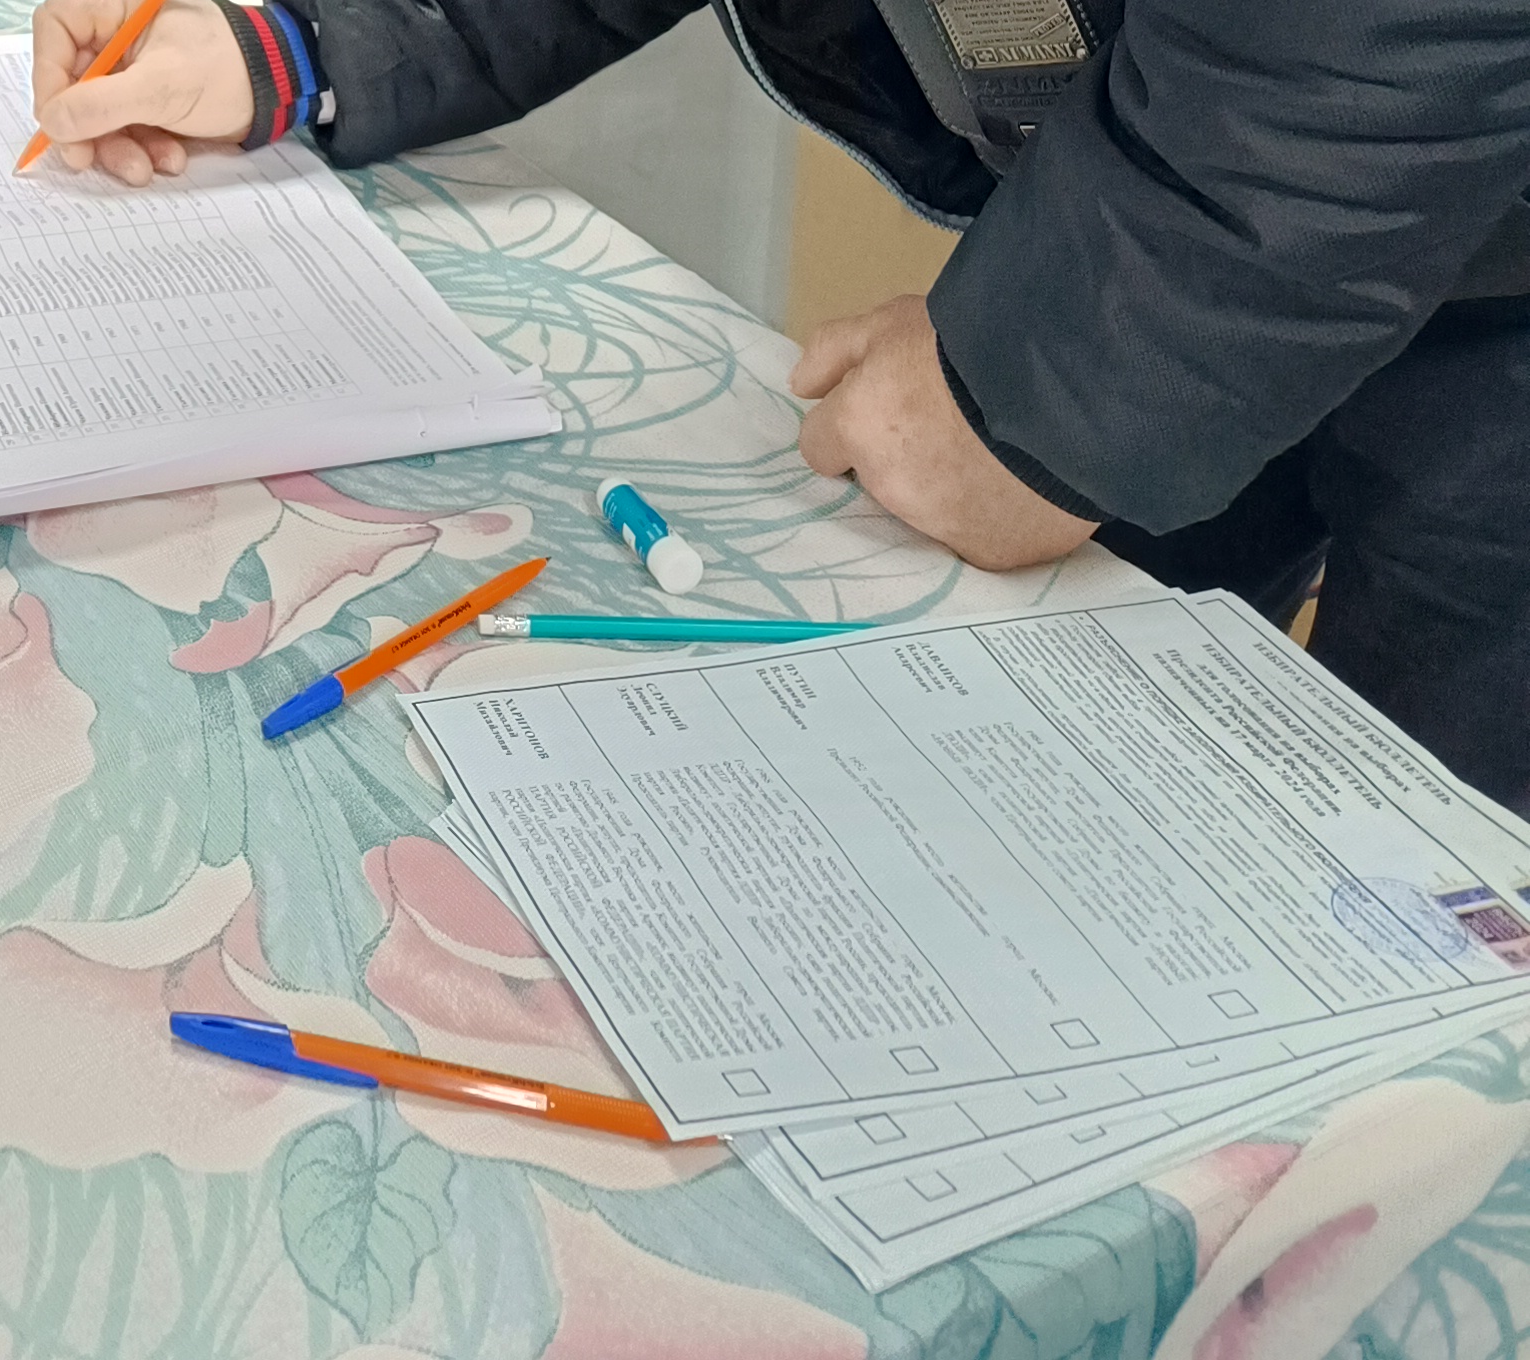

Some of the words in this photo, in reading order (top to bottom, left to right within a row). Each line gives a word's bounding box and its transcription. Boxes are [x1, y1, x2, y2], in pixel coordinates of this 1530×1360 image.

[764, 666, 812, 709] Владимир
[780, 663, 820, 699] ПУТИН
[885, 646, 939, 693] Андреевич
[900, 643, 953, 690] Владислав
[912, 641, 975, 696] ДАВАНКОВ
[486, 699, 521, 738] Николай
[613, 686, 659, 736] Эдуардович
[627, 683, 660, 715] Леонид
[642, 682, 690, 731] СЛУЦКИЙ
[750, 668, 812, 730] Владимирович
[1161, 649, 1230, 704] Президента
[1219, 703, 1286, 756] Российской
[1198, 643, 1309, 737] ИЗБИРАТЕЛЬНЫЙ
[1299, 737, 1389, 810] БЮЛЛЕТЕНЬ
[1248, 642, 1371, 731] ИЗБИРАТЕЛЬНЫЙ
[1360, 734, 1459, 805] БЮЛЛЕТЕНЬ
[471, 701, 516, 756] Михайлович
[500, 697, 551, 759] ХАРИТОНОВ
[1079, 624, 1148, 681] РАЗЪЯСНЕНИЕ
[1233, 774, 1318, 850] ИЗБИРАТЕЛЬНОГО
[1148, 652, 1221, 714] назначенных
[1213, 715, 1234, 727] на
[1228, 729, 1248, 740] 17
[1239, 741, 1278, 768] марта
[1271, 769, 1306, 793] 2024
[1297, 794, 1330, 817] года
[1195, 663, 1221, 680] для
[1214, 681, 1286, 739] голосования
[1278, 740, 1298, 751] на
[1290, 751, 1347, 795] выборах
[553, 826, 604, 888] РОССИЙСКОЙ
